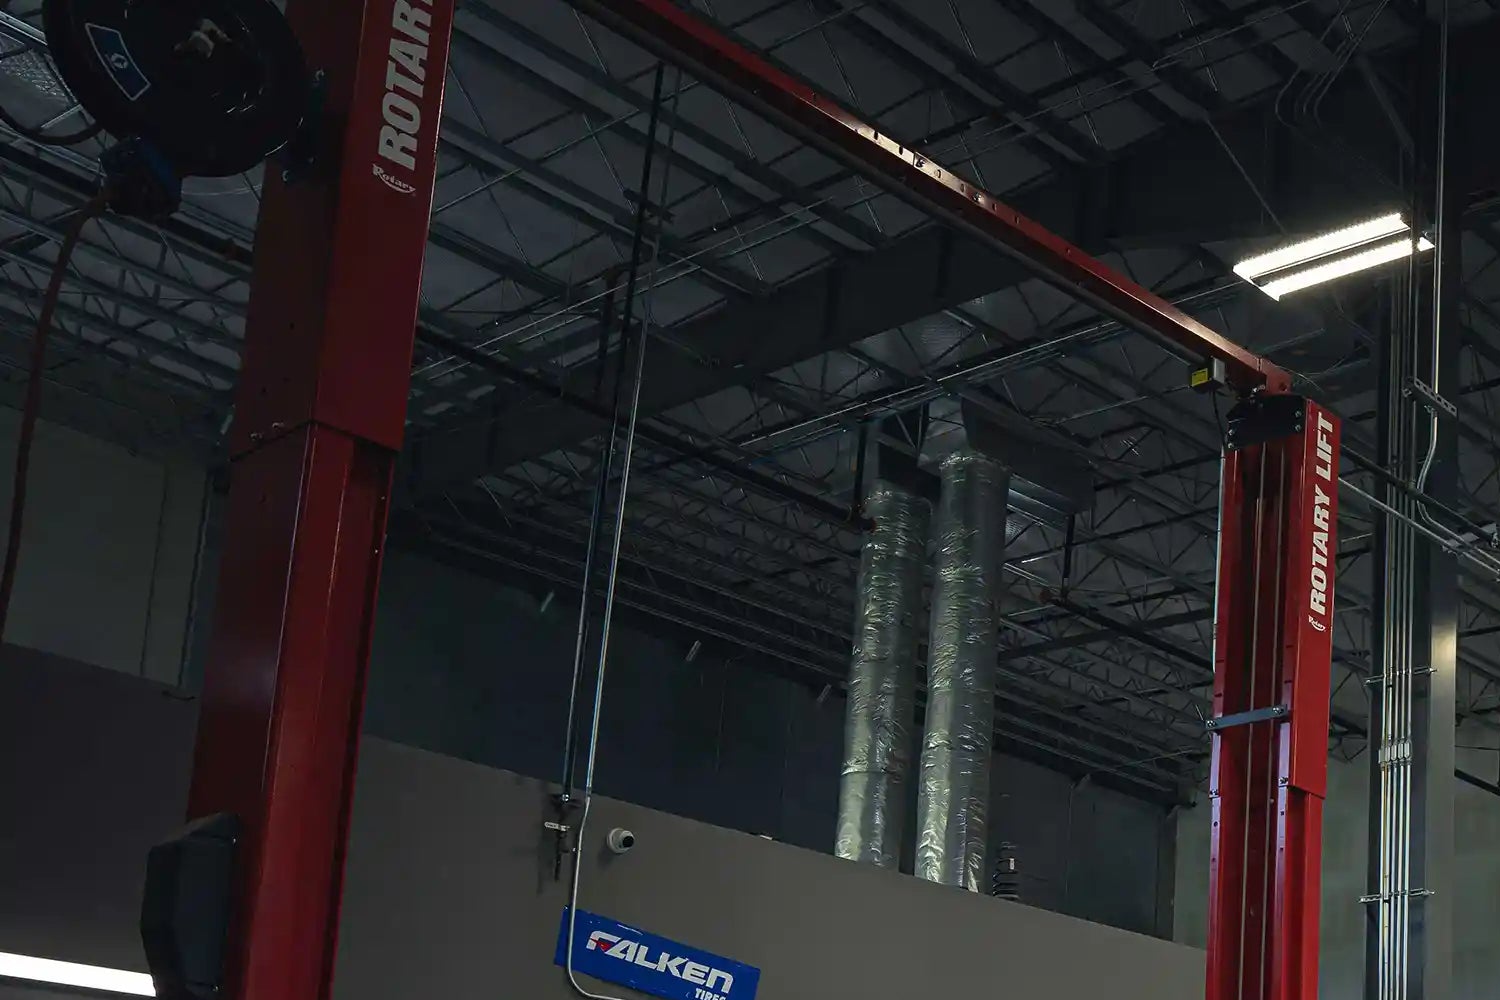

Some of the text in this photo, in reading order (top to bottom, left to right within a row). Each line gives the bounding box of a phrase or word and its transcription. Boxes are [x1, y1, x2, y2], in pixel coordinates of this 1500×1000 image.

[378, 0, 433, 171] ROTAR
[372, 163, 416, 194] Rotary
[1310, 412, 1334, 616] ROTARY LIFT
[586, 930, 734, 994] FALKEN
